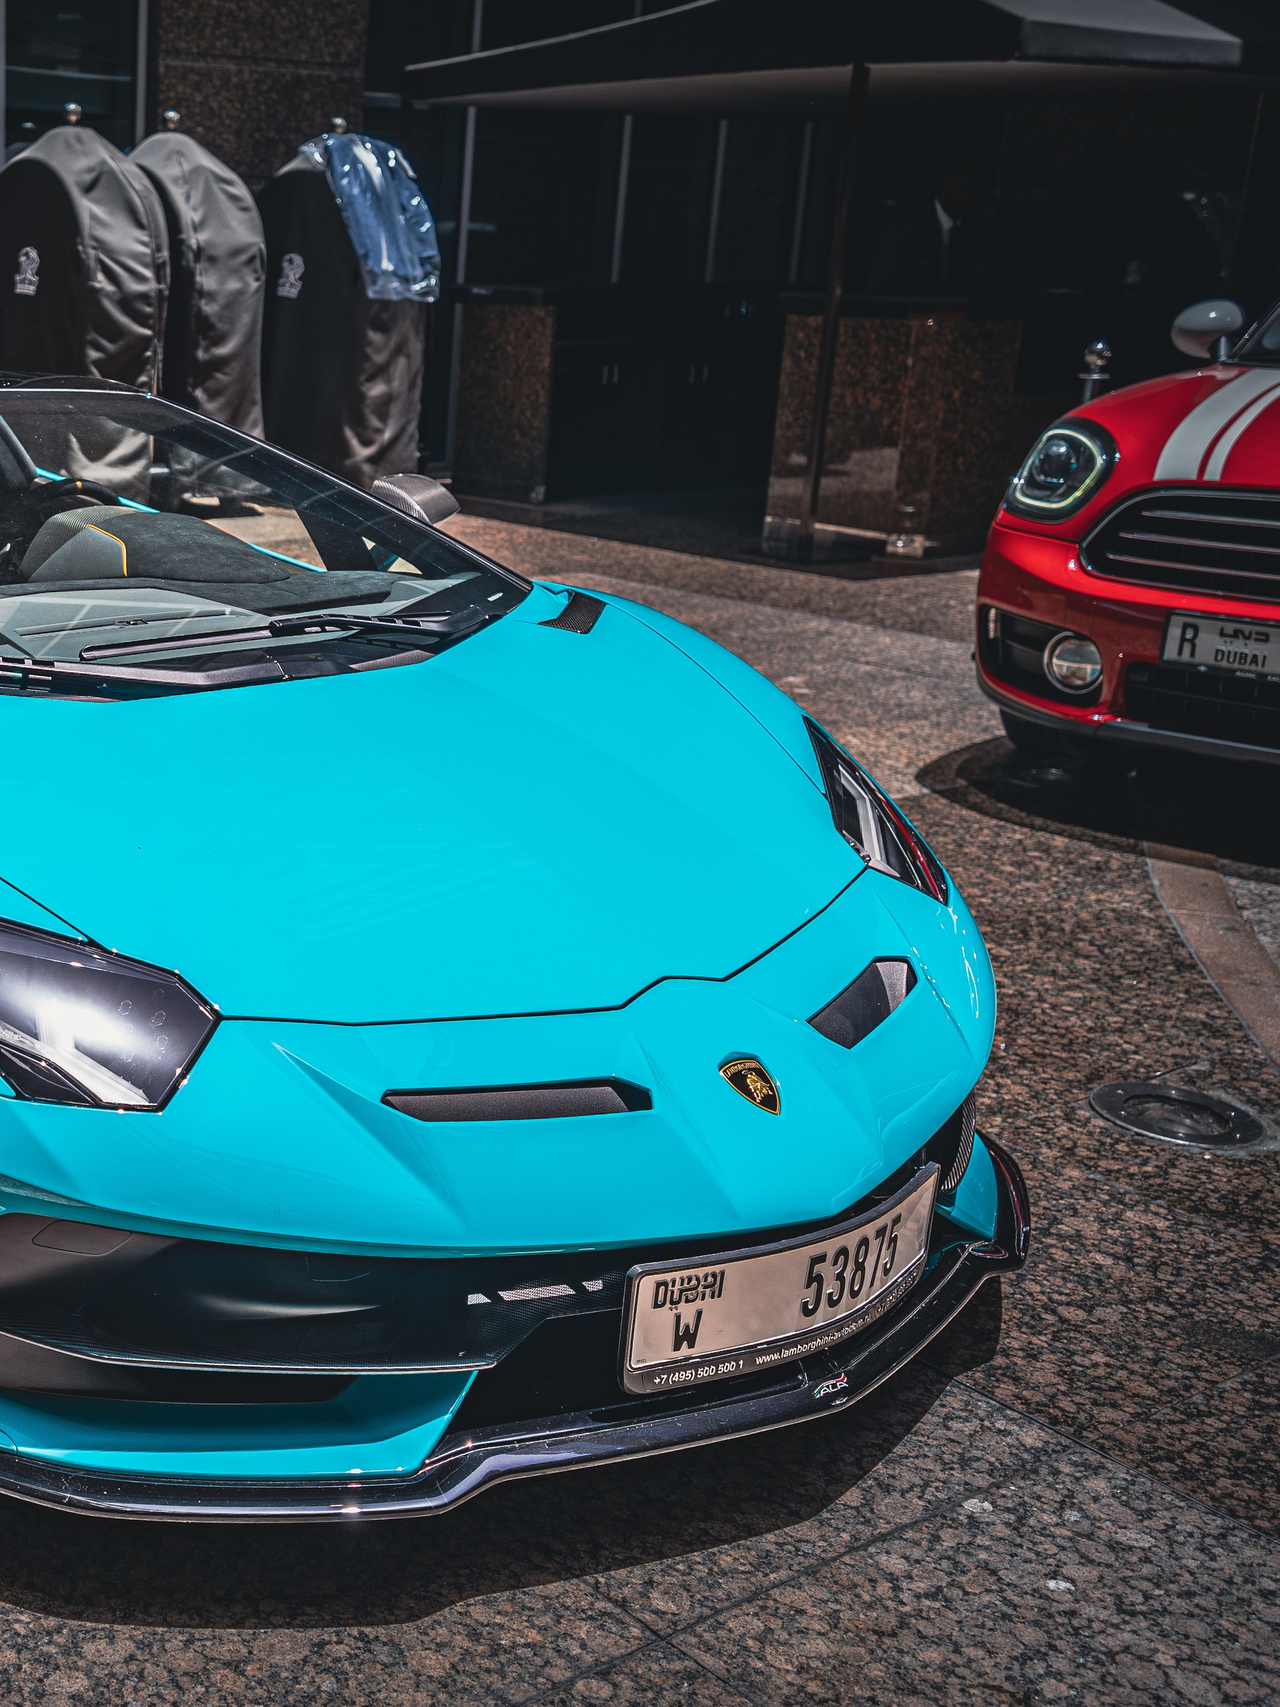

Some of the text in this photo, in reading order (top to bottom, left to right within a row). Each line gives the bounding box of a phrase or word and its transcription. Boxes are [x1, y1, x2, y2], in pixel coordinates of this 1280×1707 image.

[1177, 621, 1200, 659] R
[1214, 648, 1268, 668] DUBAI
[801, 1212, 902, 1318] 53875
[651, 1269, 726, 1310] DUBAI
[672, 1308, 704, 1352] W
[755, 1313, 872, 1365] www.lamborghini-avtodom.ru
[653, 1359, 744, 1385] +7 (495) 500 500 1
[820, 1381, 849, 1397] ALA
